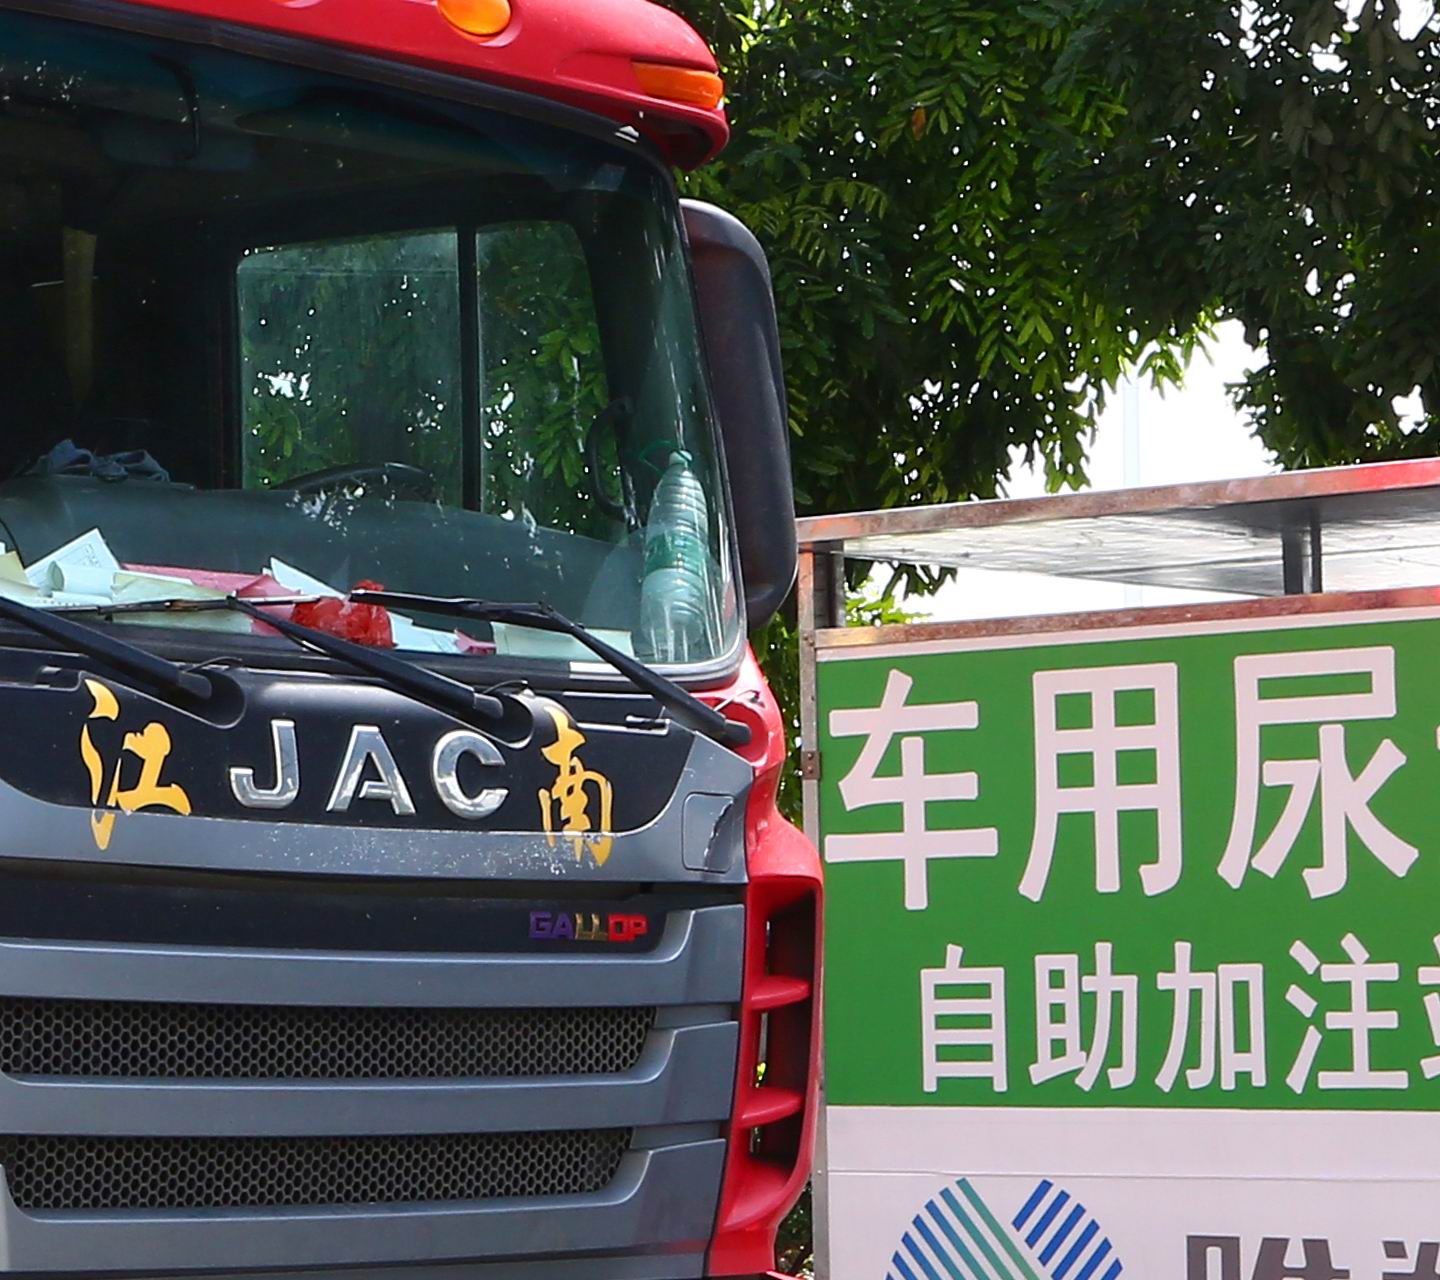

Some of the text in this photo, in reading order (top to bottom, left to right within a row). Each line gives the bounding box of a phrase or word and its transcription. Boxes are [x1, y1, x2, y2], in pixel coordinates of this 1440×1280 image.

[80, 677, 614, 867] 江 JAC 南
[527, 910, 649, 943] GALLOP
